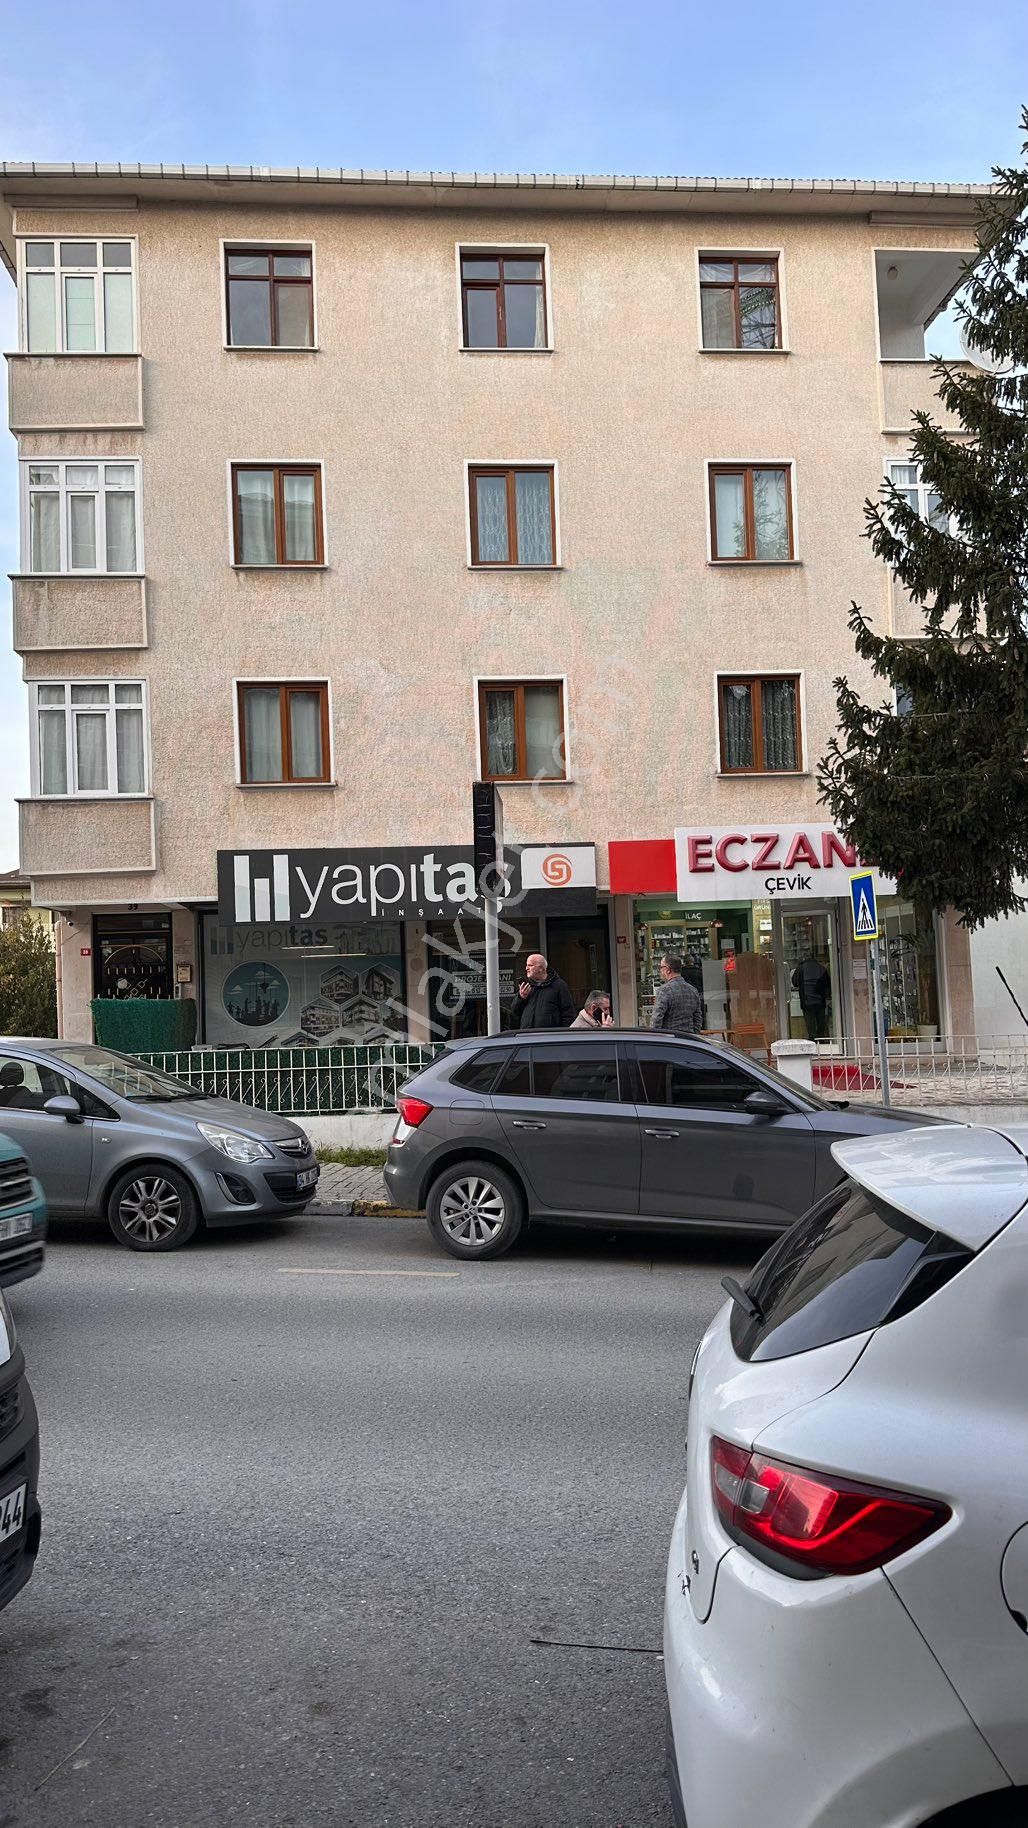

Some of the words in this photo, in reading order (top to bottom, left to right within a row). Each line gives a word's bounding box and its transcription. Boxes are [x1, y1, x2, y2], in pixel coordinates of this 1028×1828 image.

[687, 831, 880, 873] ECZAN
[764, 873, 812, 895] ÇEVİK
[0, 1491, 22, 1534] 44
